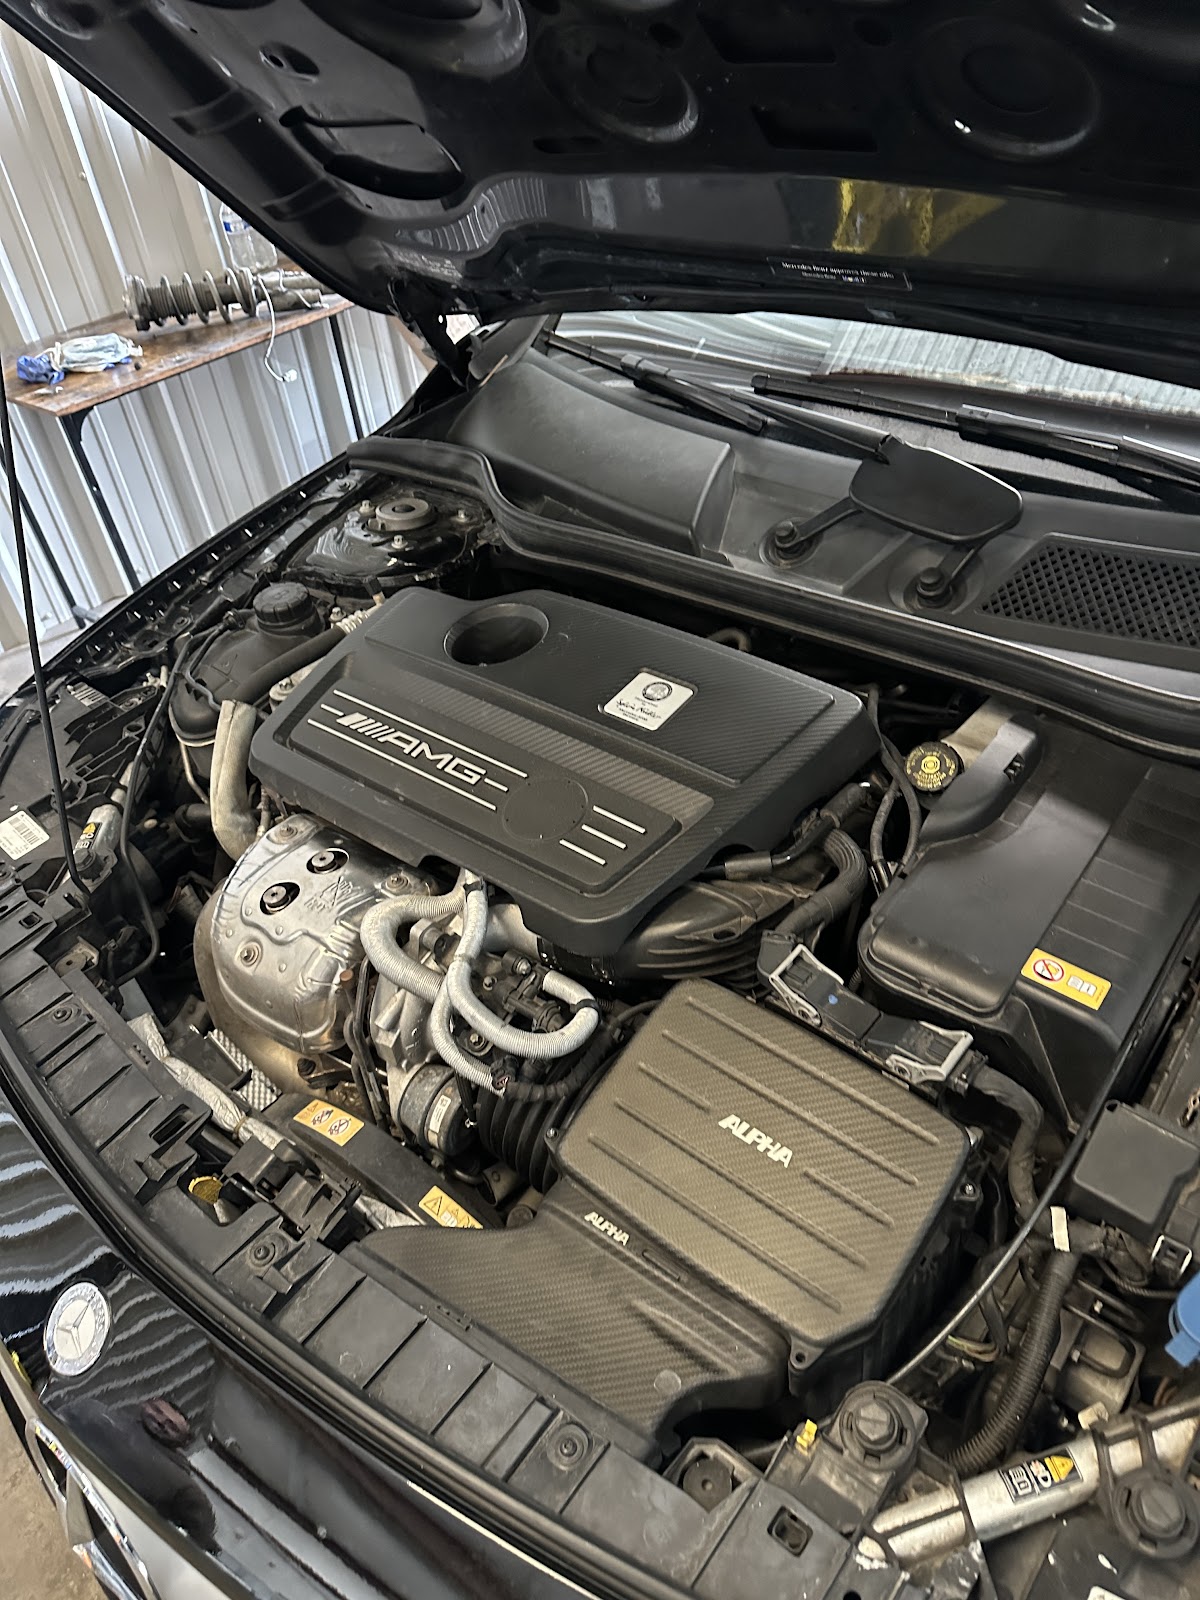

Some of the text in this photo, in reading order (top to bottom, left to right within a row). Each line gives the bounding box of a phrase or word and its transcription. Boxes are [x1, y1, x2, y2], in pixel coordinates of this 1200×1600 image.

[377, 729, 487, 786] AMG
[718, 1114, 793, 1168] ALPHA
[584, 1211, 630, 1246] ALPHA
